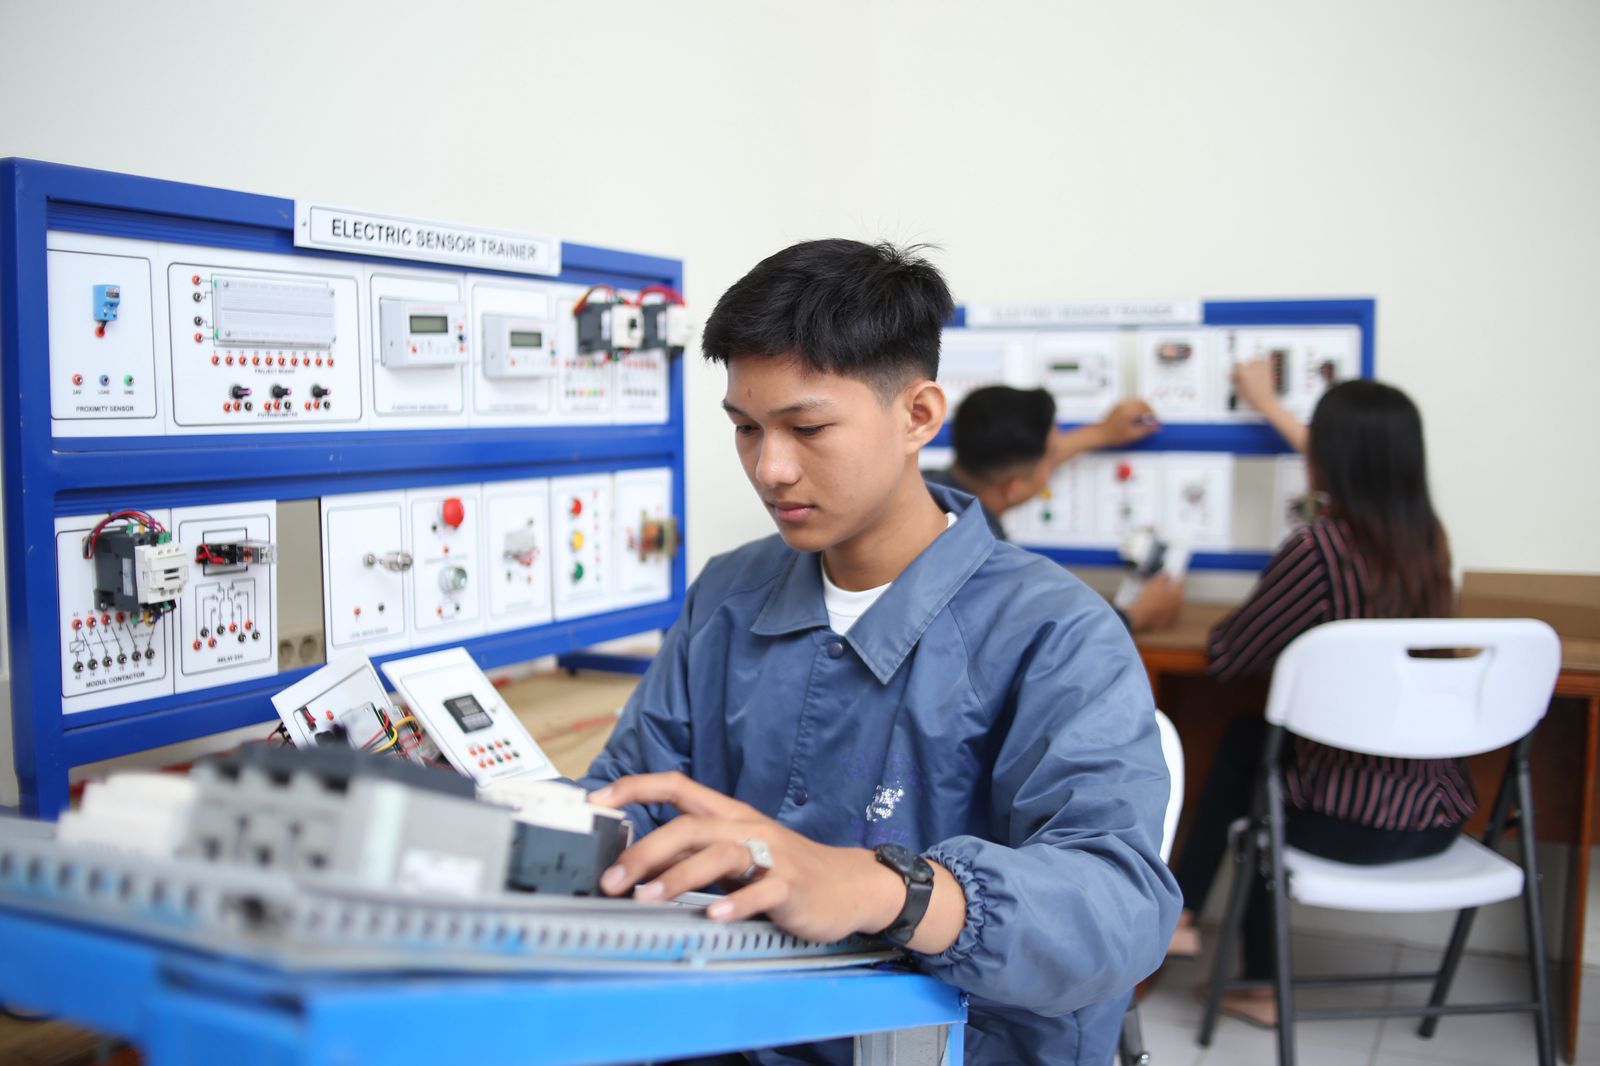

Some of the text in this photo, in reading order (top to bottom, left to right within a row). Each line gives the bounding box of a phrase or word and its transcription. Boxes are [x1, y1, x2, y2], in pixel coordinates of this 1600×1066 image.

[331, 218, 537, 261] ELECTRIC SENSOR TRAINER
[76, 405, 108, 413] PROXIMITY
[86, 671, 145, 688] MODUL CONTACTOR
